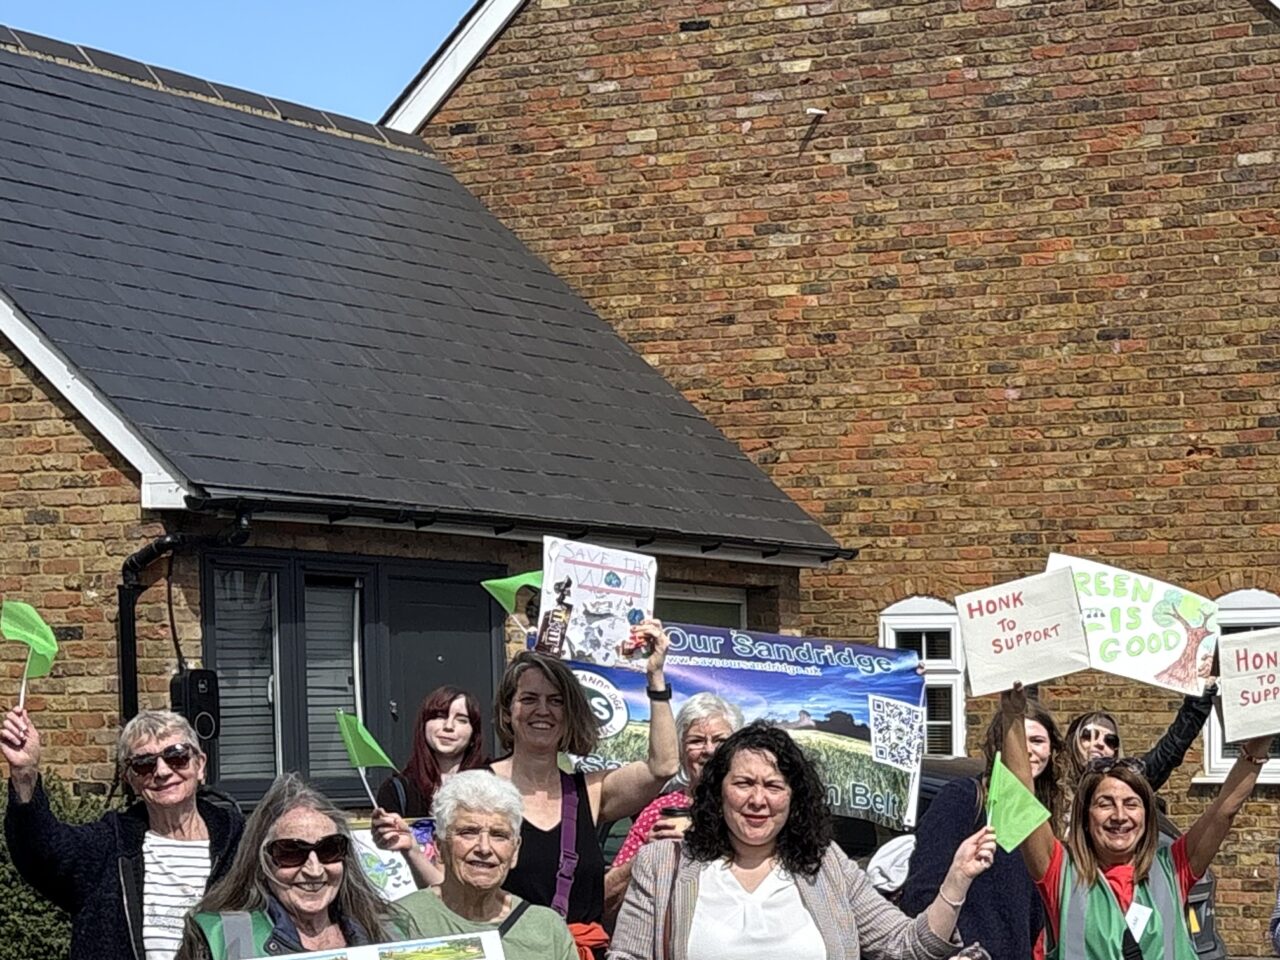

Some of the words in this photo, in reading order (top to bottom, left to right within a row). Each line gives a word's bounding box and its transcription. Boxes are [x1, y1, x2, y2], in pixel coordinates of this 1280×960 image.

[1075, 571, 1154, 602] REEN
[967, 591, 1024, 619] HONK
[1110, 607, 1142, 633] IS
[663, 627, 724, 654] Our
[731, 633, 894, 674] Sandridge
[991, 624, 1061, 654] SUPPORT
[1100, 629, 1181, 662] GOOD
[1257, 674, 1276, 686] TO
[850, 782, 900, 820] Belt
